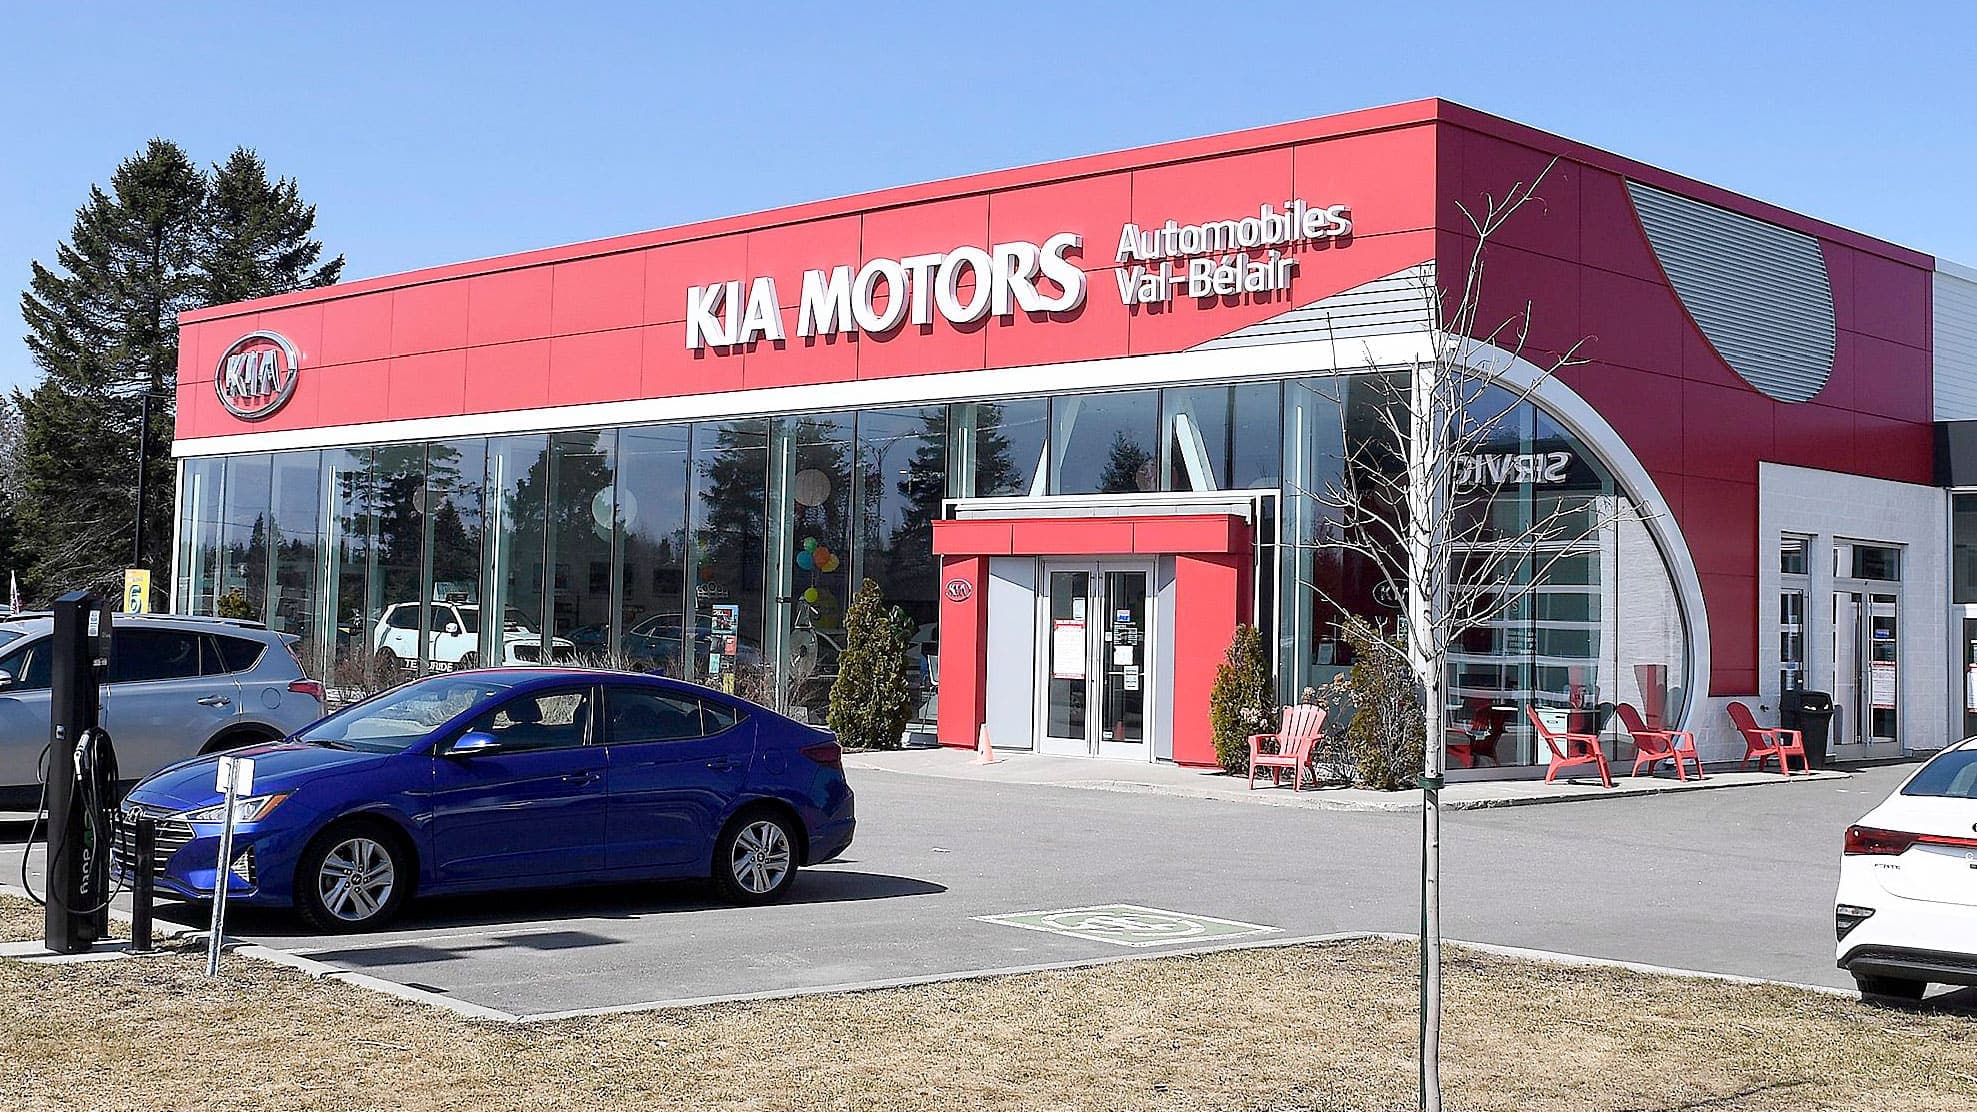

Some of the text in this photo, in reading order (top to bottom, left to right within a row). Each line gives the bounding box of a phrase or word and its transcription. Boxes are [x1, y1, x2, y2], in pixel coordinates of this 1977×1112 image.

[1114, 199, 1351, 262] Automobiles
[685, 232, 1085, 349] KIA MOTORS
[1114, 248, 1296, 305] Val-Bélair
